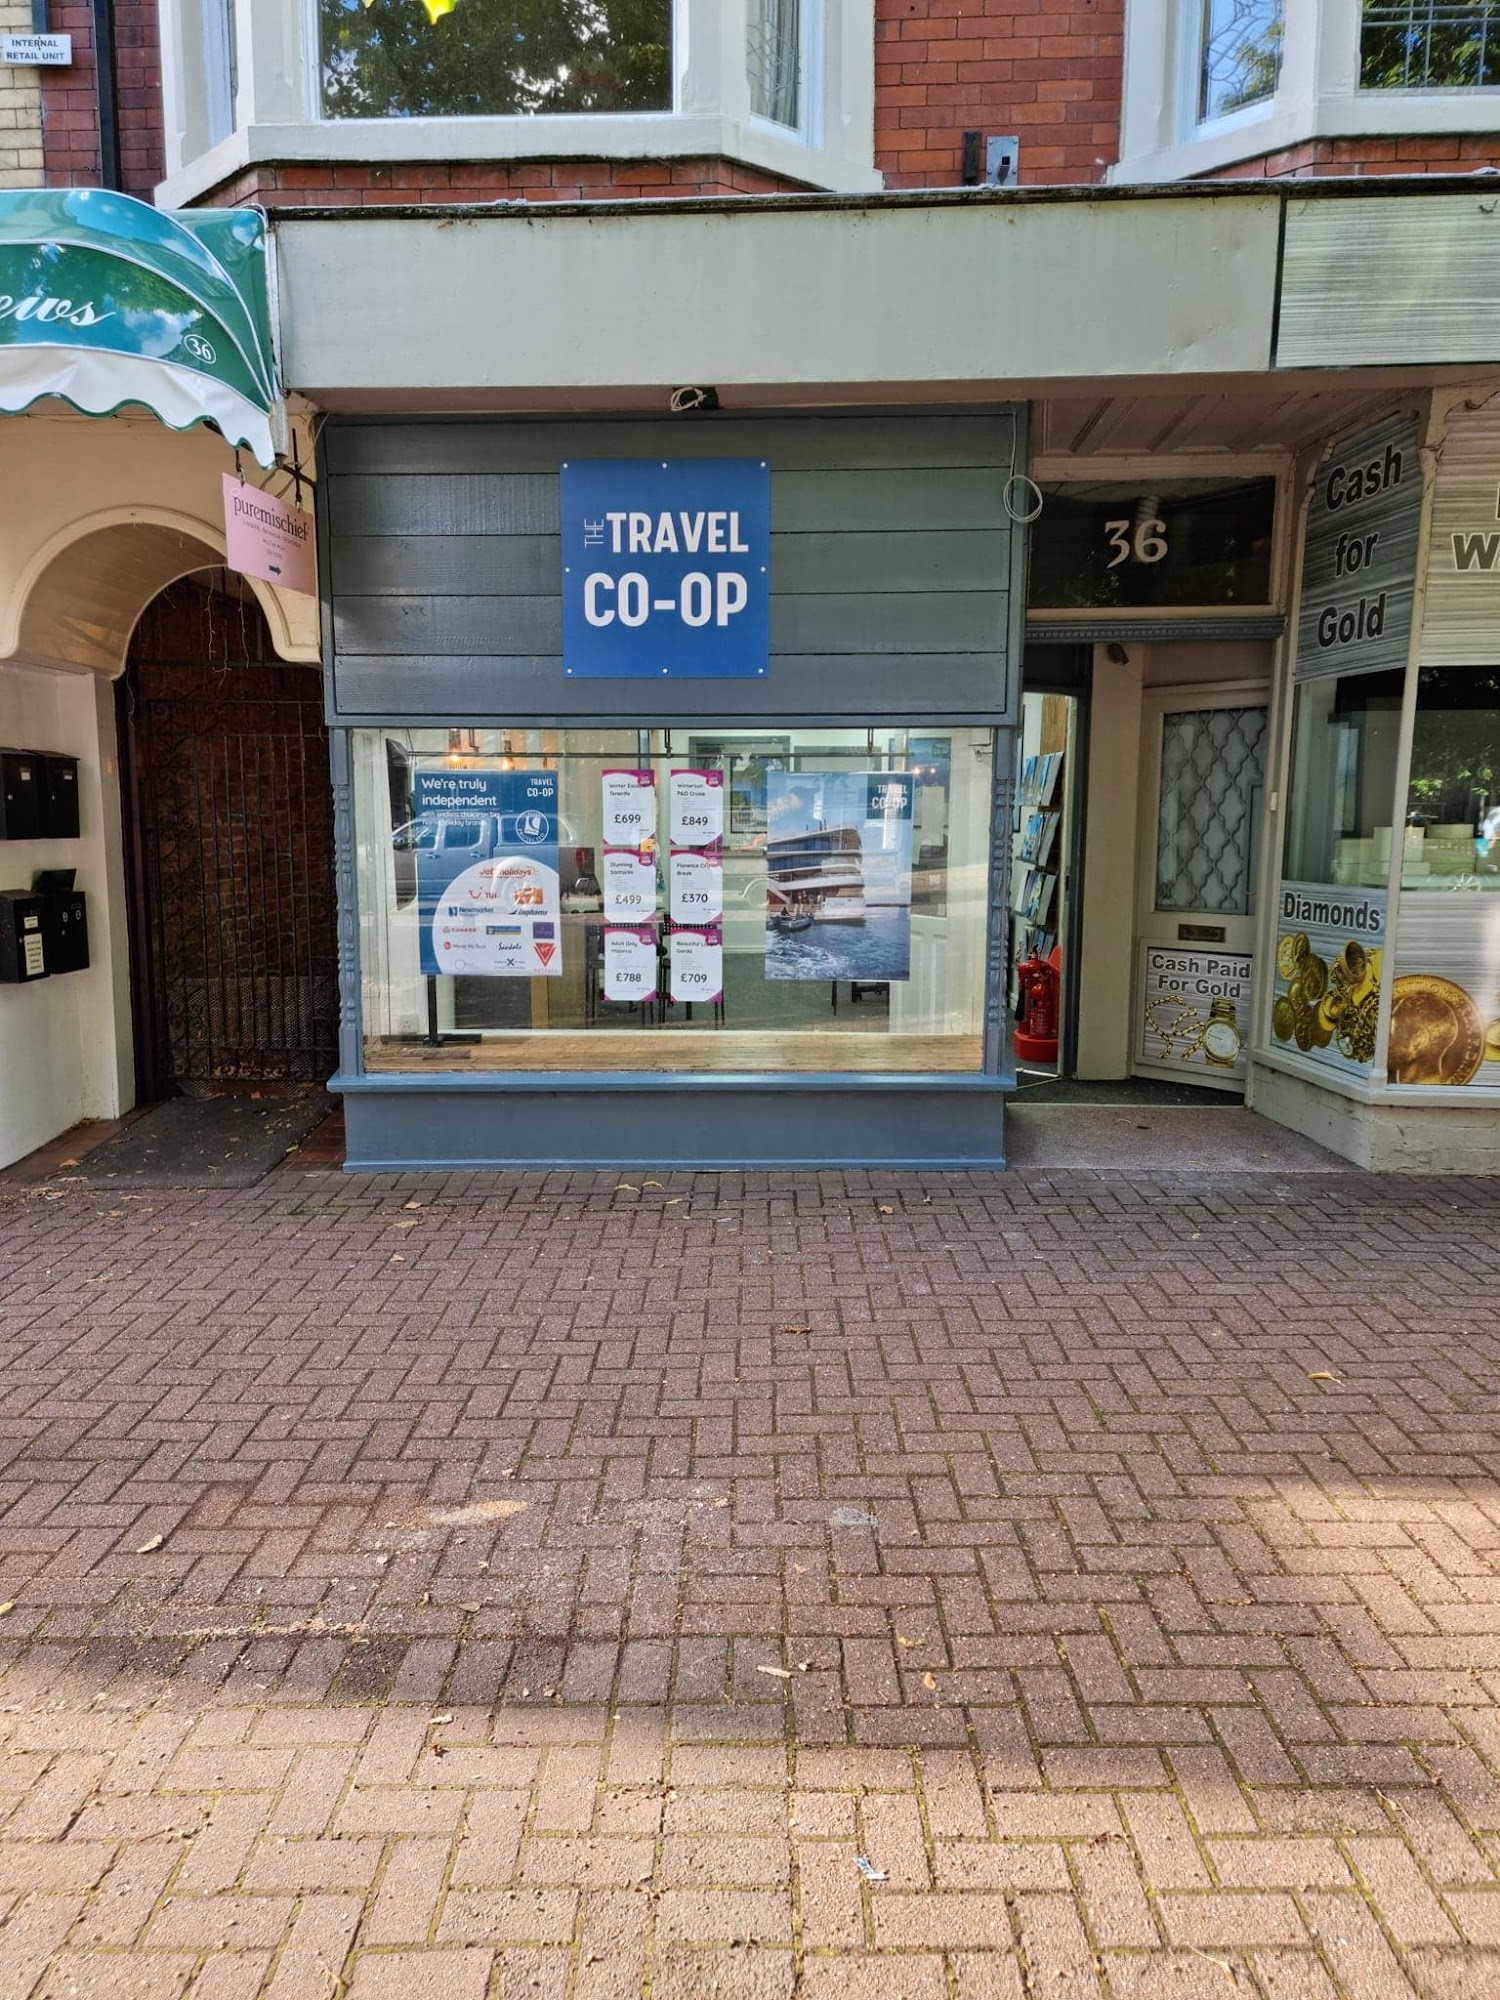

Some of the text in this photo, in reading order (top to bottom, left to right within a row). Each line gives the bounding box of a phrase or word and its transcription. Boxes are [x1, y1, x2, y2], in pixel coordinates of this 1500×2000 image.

[11, 39, 59, 47] INTERNAL
[6, 52, 65, 60] RETAIL UNIT
[189, 338, 212, 360] 36
[1326, 442, 1403, 512] Cash
[234, 497, 308, 541] puremischief
[584, 512, 749, 553] THE TRAVEL
[1104, 519, 1168, 569] 36
[1334, 531, 1380, 578] for
[584, 572, 748, 627] CO-OP
[1317, 591, 1388, 649] Gold
[421, 778, 487, 792] We're truly
[530, 778, 554, 786] TRAVEL
[527, 787, 554, 797] CO-OP
[422, 794, 497, 808] independent
[614, 813, 642, 824] £699
[681, 816, 709, 826] £849
[615, 894, 642, 905] £499
[681, 893, 709, 903] £370
[1283, 892, 1383, 933] Diamonds
[1151, 954, 1251, 979] Cash Paid
[616, 972, 642, 983] £788
[680, 973, 708, 983] £709
[1157, 975, 1242, 999] For Gold
